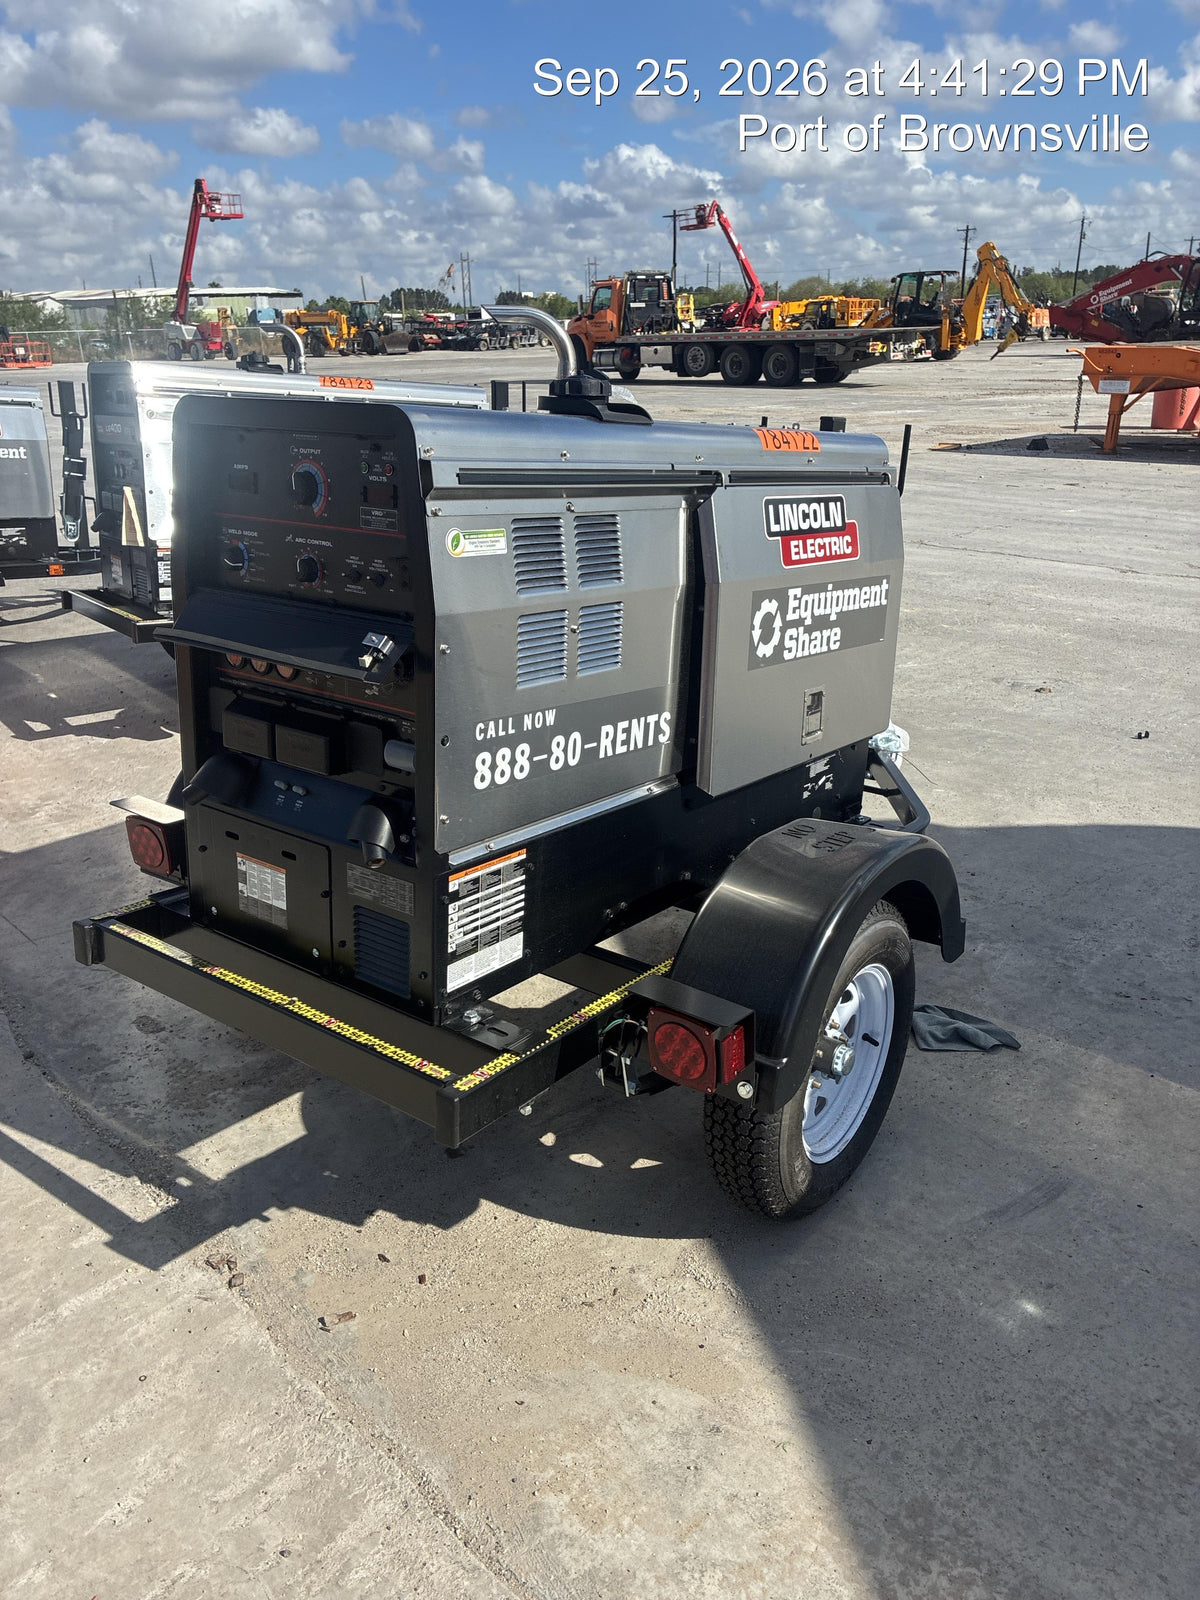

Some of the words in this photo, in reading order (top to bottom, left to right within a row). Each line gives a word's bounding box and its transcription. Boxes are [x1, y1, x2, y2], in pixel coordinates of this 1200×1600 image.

[368, 475, 388, 483] VOLTS
[768, 501, 843, 533] LINCOLN
[307, 538, 333, 547] CONTROL
[790, 535, 852, 560] ELECTRIC
[786, 578, 889, 625] Equipment
[783, 626, 841, 661] Share
[475, 717, 516, 741] CALL
[523, 708, 557, 731] NOW
[473, 711, 672, 791] 888-80-RENTS
[781, 824, 817, 839] NO
[811, 831, 857, 853] STEP
[335, 1023, 350, 1033] NO
[390, 1050, 416, 1063] AQUI
[487, 1061, 504, 1072] DO
